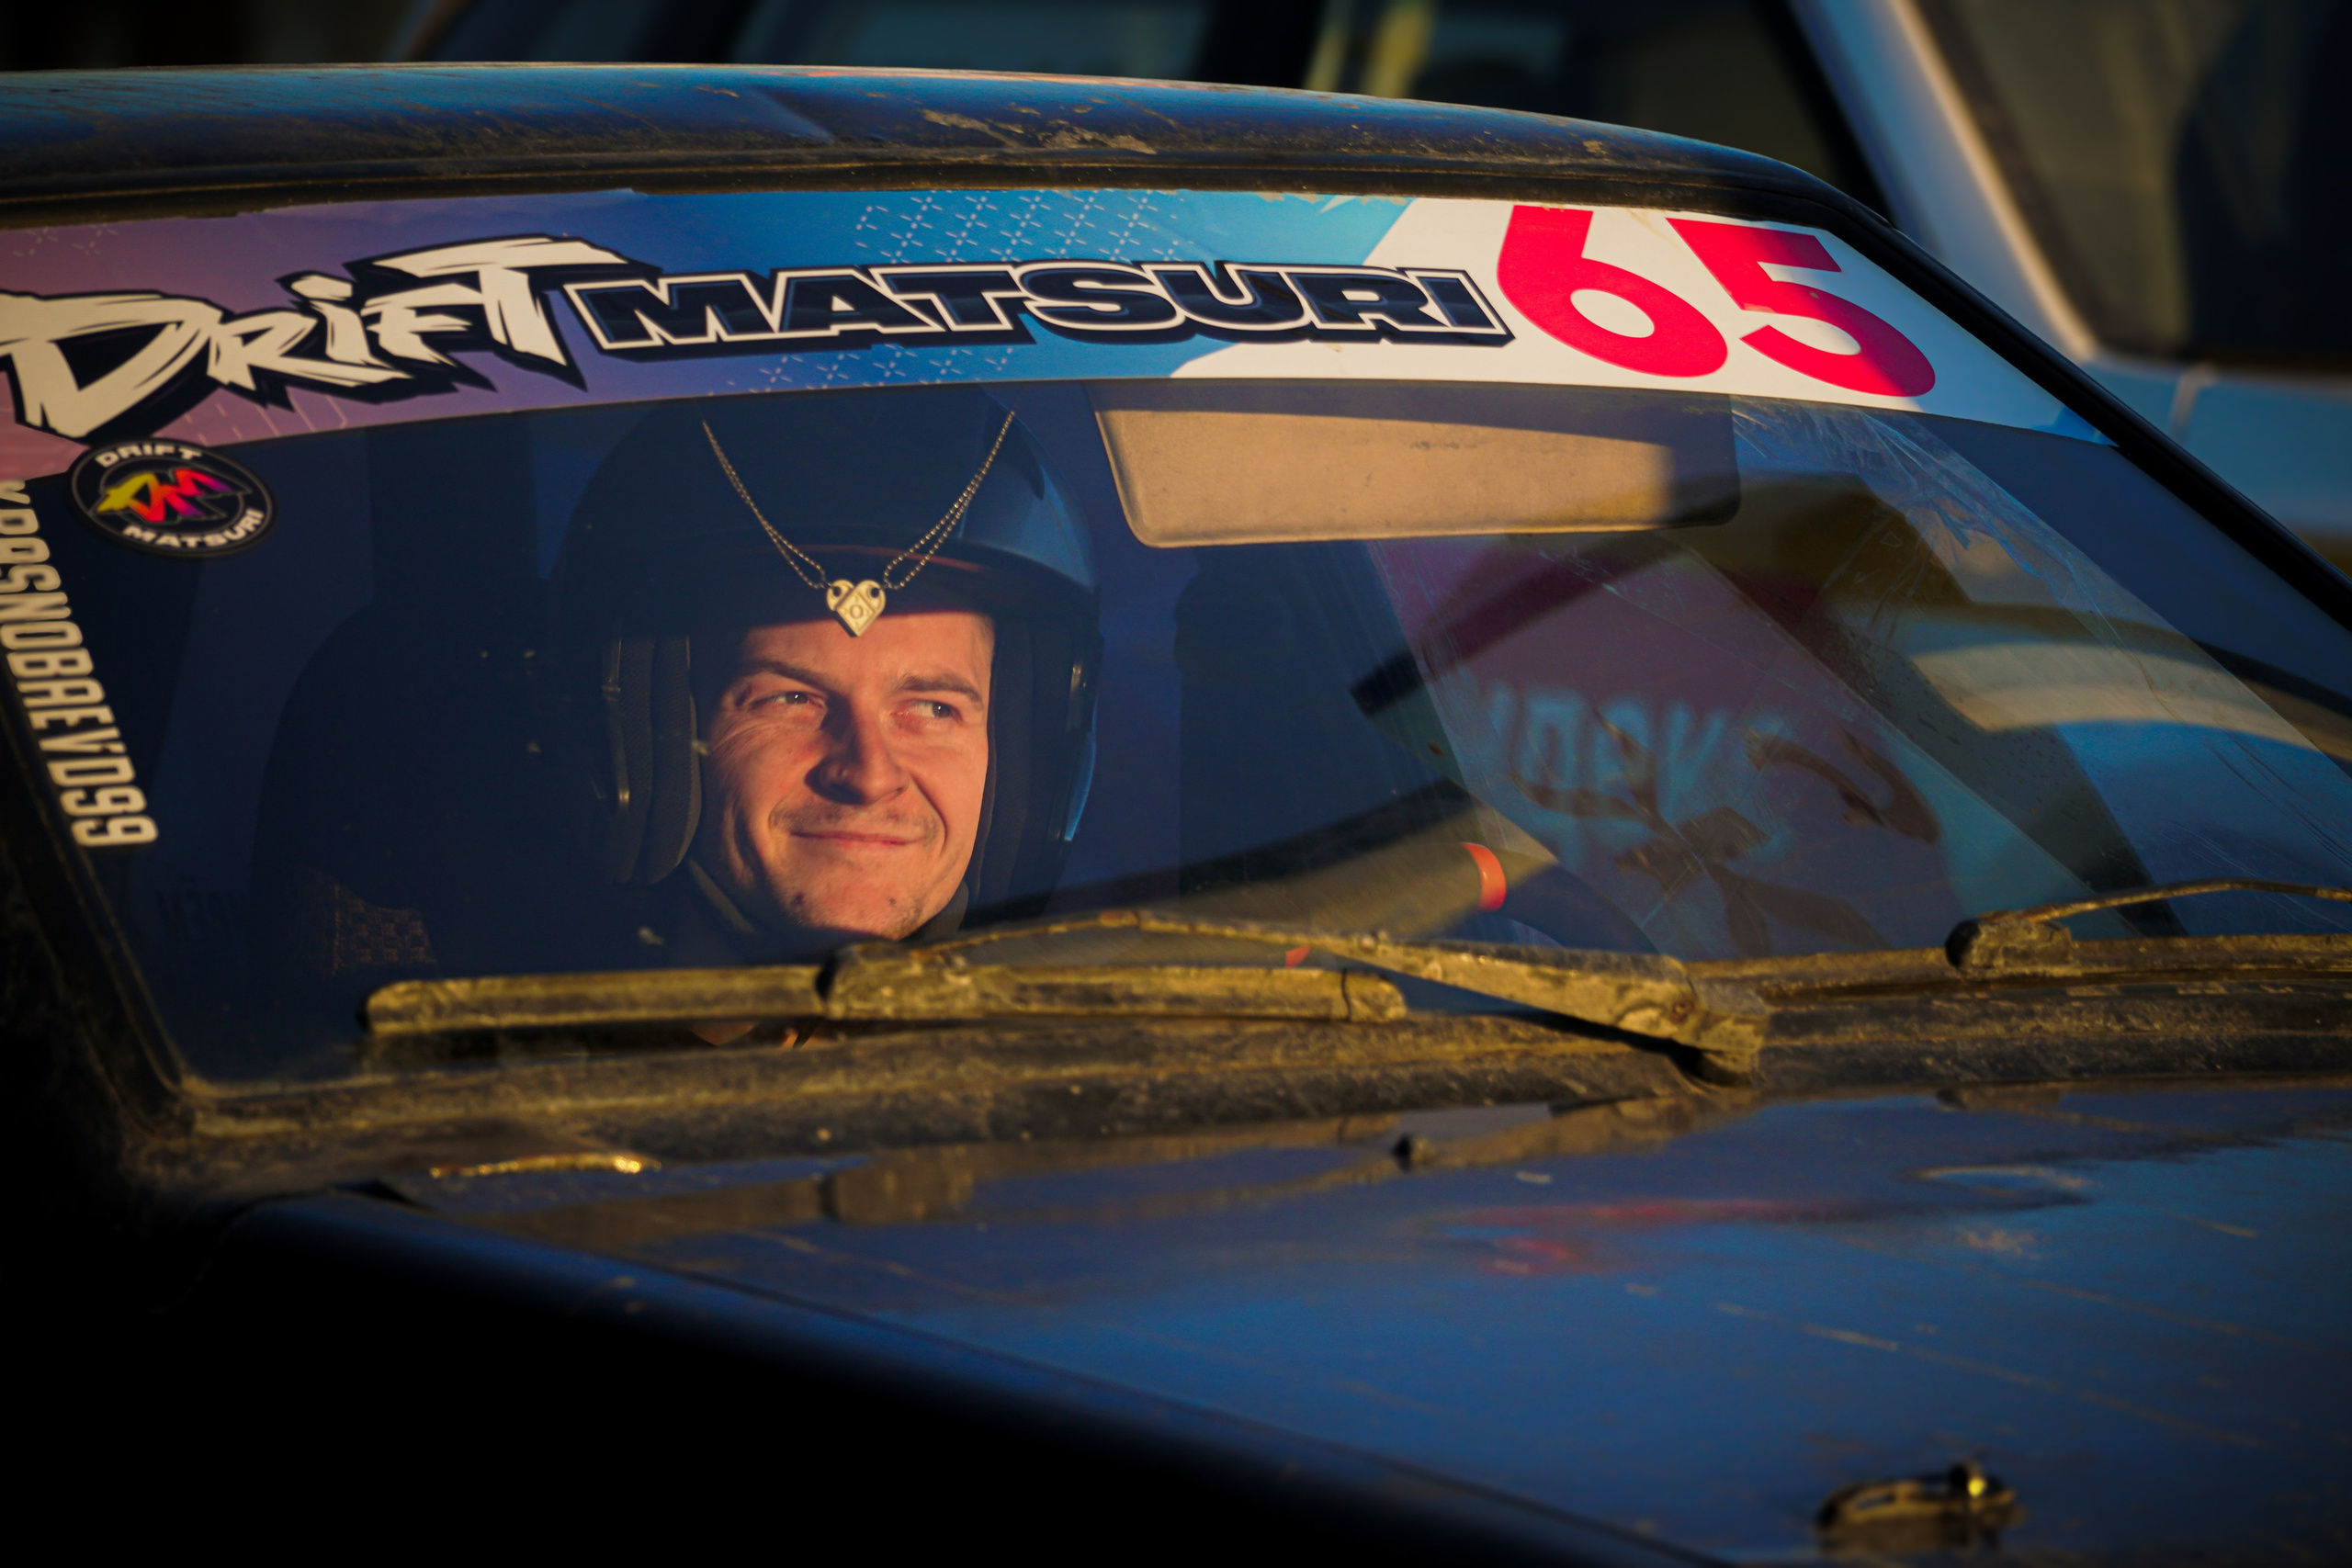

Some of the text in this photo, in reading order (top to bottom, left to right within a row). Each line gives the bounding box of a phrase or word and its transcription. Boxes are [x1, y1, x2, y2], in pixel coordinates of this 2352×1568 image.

[563, 262, 1510, 354] MATSURI
[1498, 204, 1936, 398] 65
[95, 444, 202, 468] DRIFT
[120, 507, 265, 548] MATSURI
